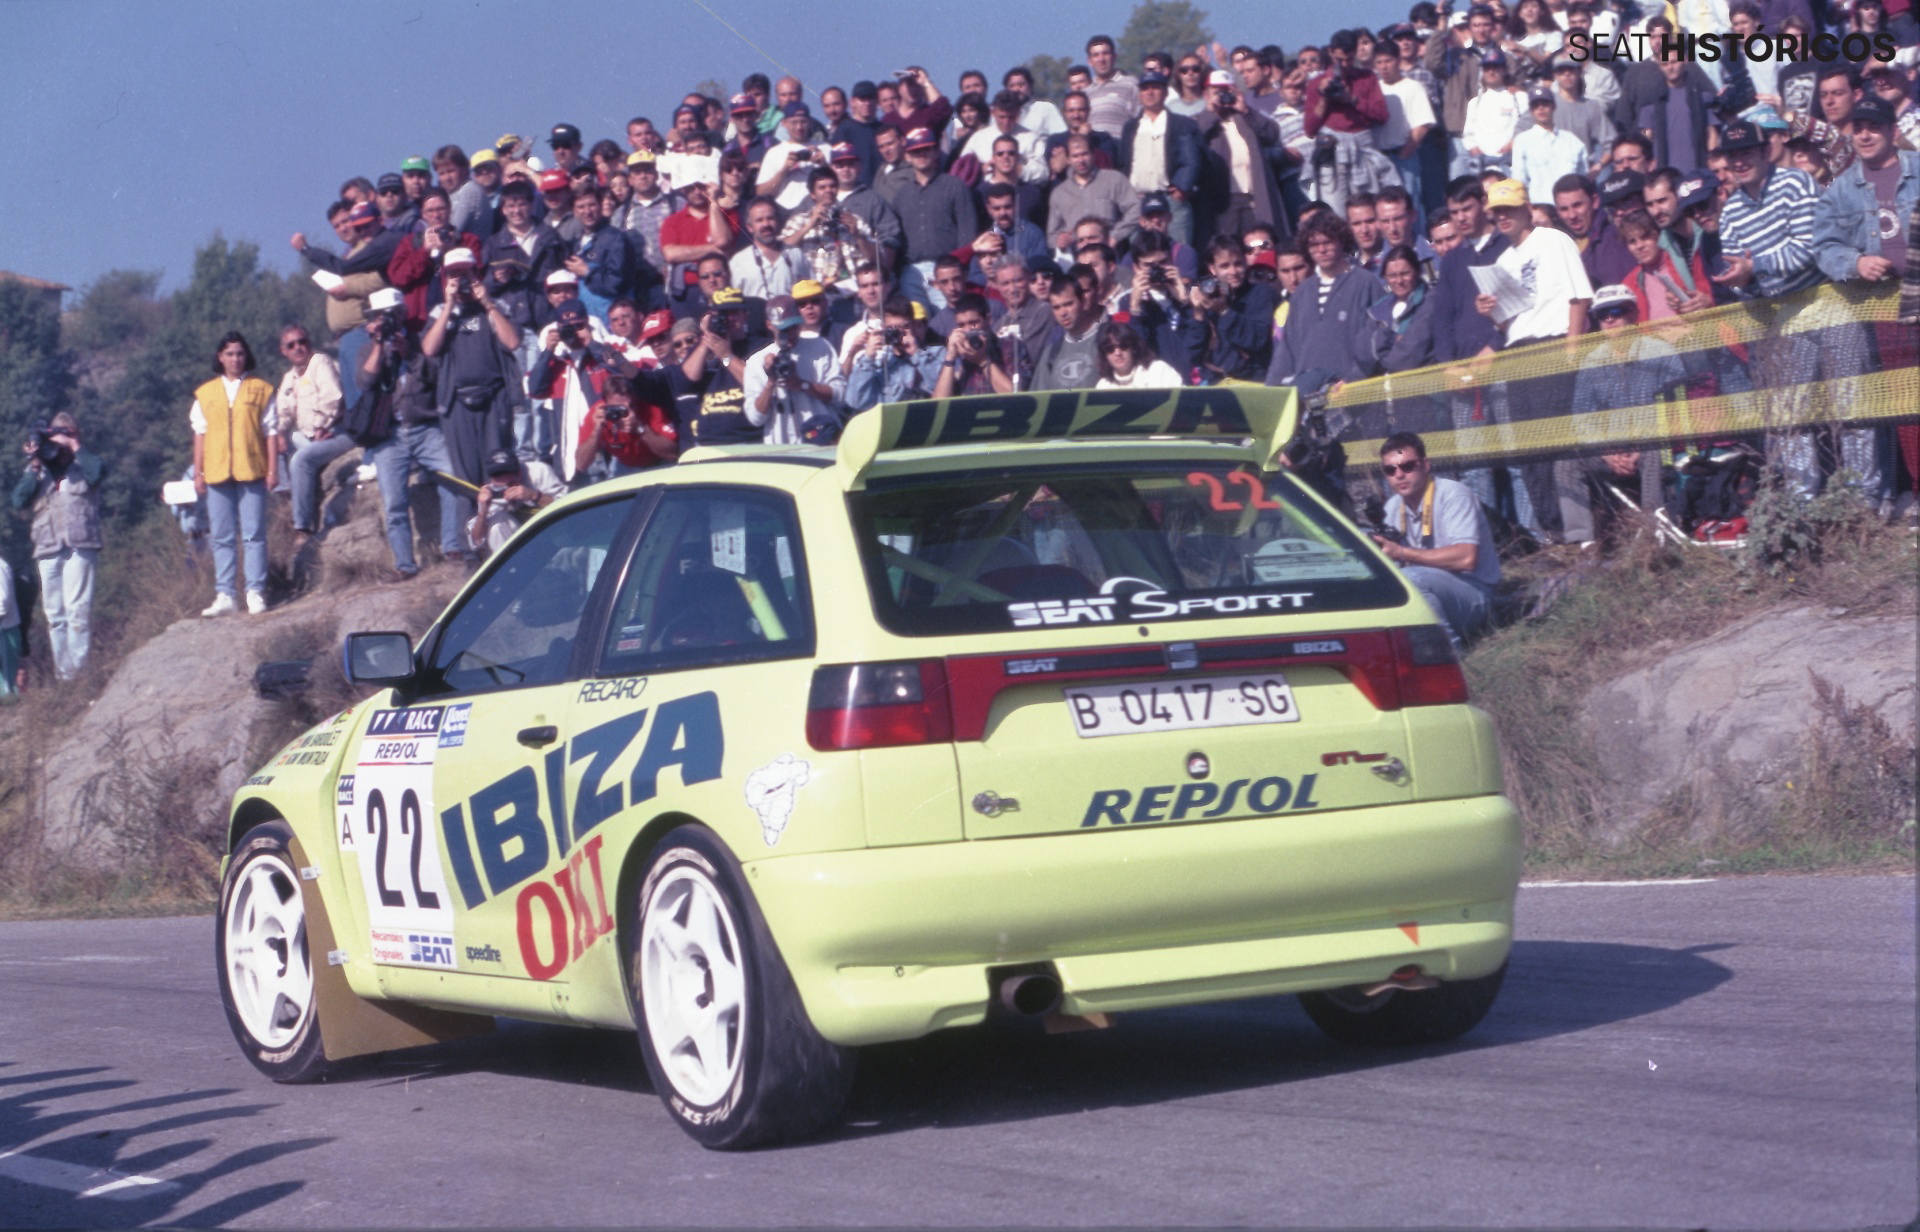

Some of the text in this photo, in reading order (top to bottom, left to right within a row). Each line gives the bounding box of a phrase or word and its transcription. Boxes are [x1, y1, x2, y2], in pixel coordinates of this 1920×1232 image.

[895, 388, 1253, 448] IBIZA
[1187, 472, 1282, 511] 22
[1008, 597, 1116, 626] SEAT
[1293, 640, 1344, 655] IBIZA
[1007, 658, 1058, 674] SEAT
[576, 677, 648, 704] RECARO
[1070, 680, 1290, 730] B 0417 SG
[405, 709, 439, 731] RACC
[374, 742, 419, 759] REPSOL
[337, 791, 354, 802] RACC
[440, 690, 724, 911] IBIZA
[1080, 773, 1319, 828] REPSOL
[342, 813, 354, 844] A
[366, 788, 441, 909] 22
[516, 832, 614, 982] OKI
[371, 930, 404, 943] Recambios
[408, 934, 453, 964] SEAT
[374, 946, 404, 960] Originales
[465, 944, 501, 963] speedline
